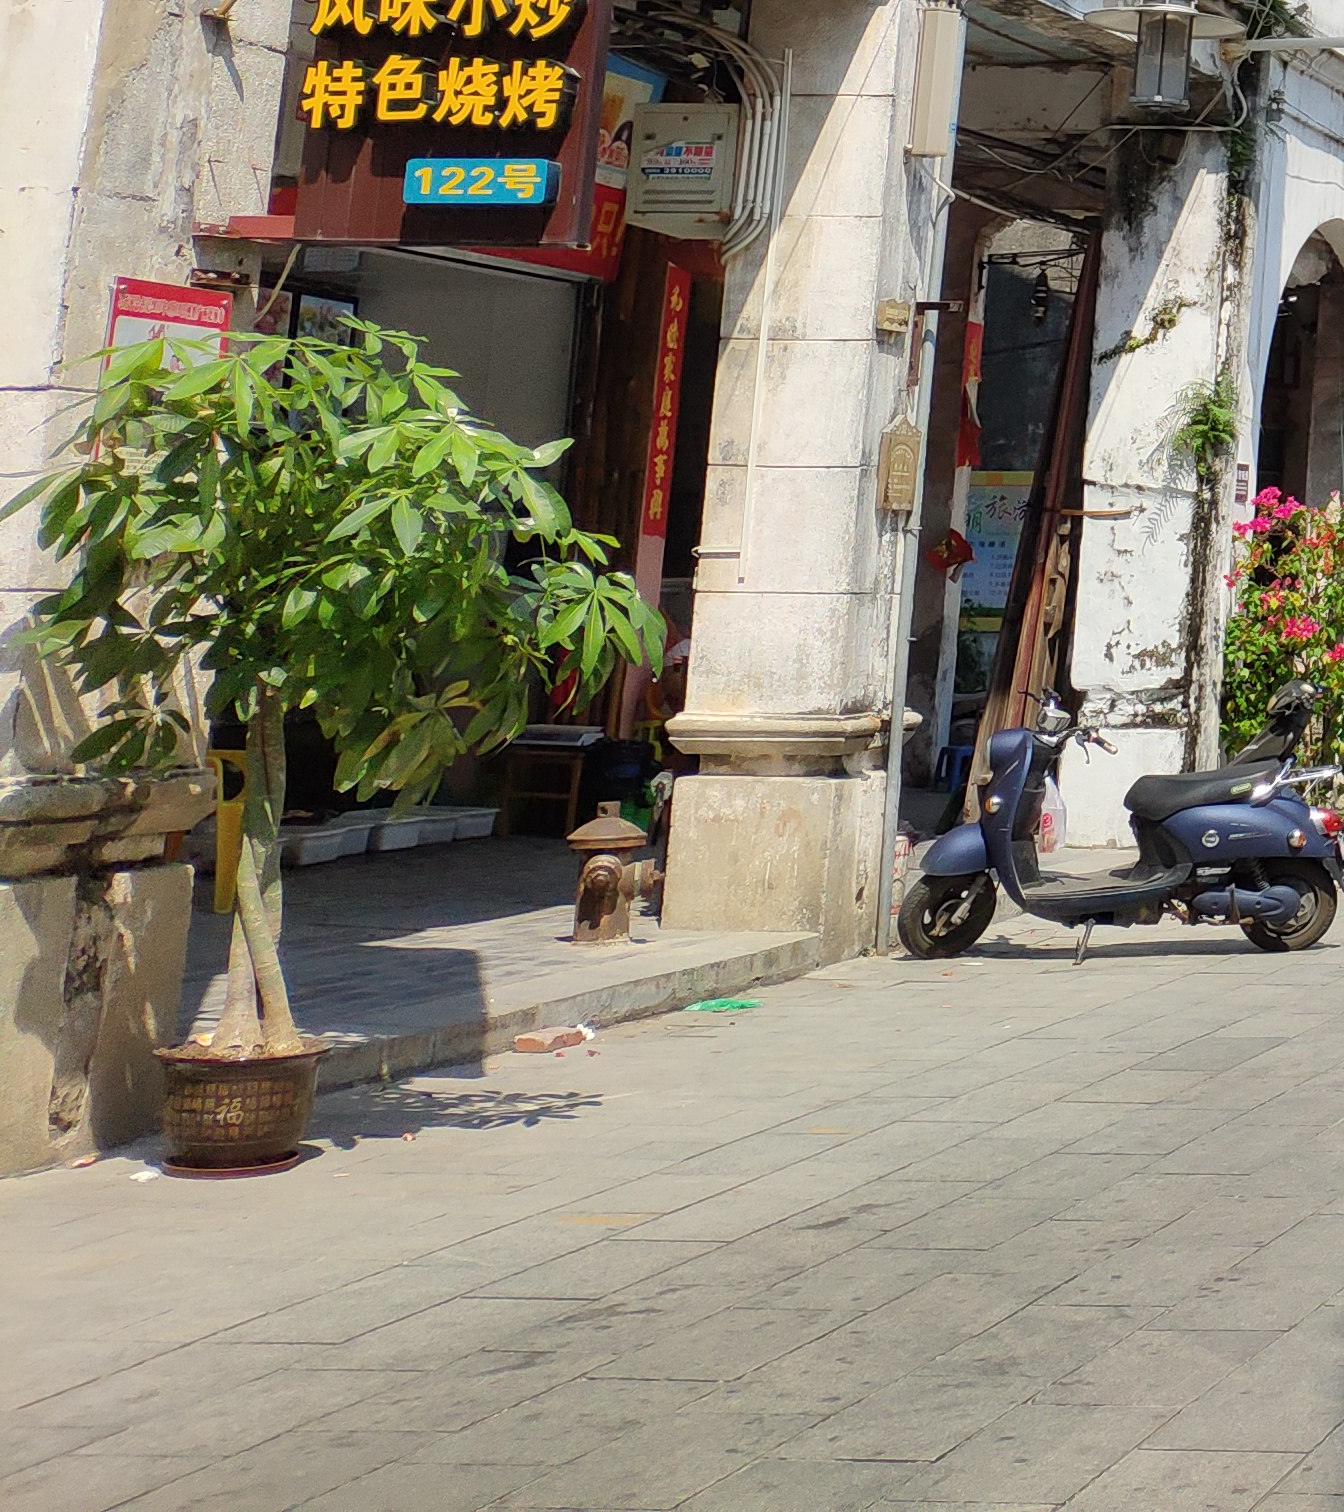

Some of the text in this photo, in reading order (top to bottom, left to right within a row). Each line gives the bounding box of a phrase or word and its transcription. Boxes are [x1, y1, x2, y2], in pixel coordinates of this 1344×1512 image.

[300, 53, 564, 129] 特色烧烤
[413, 163, 542, 198] 122号
[215, 1097, 244, 1126] 福
